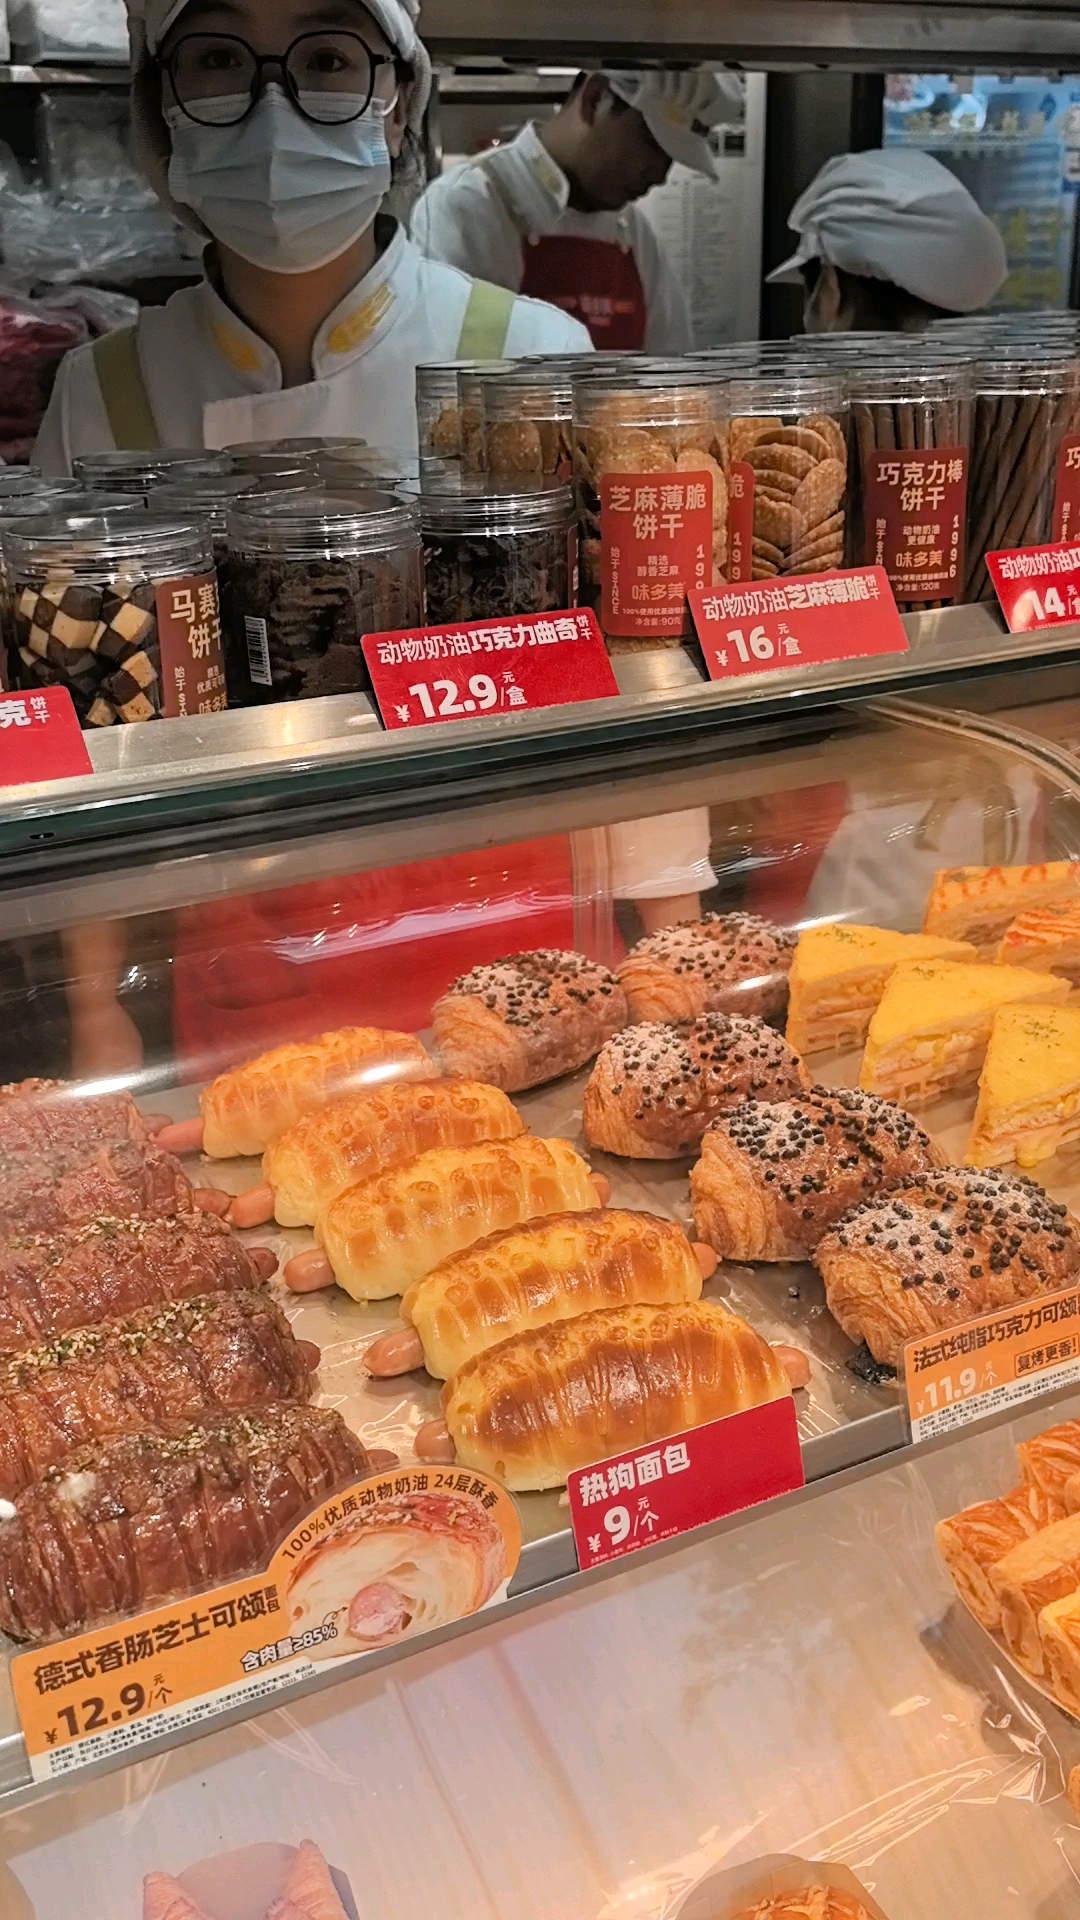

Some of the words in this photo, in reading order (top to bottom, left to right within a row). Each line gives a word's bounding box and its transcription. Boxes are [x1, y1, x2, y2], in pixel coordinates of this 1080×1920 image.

[876, 459, 964, 486] 巧克力棒
[609, 483, 707, 512] 芝麻薄脆
[900, 487, 945, 512] 饼干
[633, 514, 684, 540] 饼干
[903, 524, 940, 535] 动物奶油
[647, 555, 669, 566] 精选
[896, 550, 943, 568] 味多美
[949, 515, 960, 578] 1996
[170, 581, 221, 624] 马赛
[632, 583, 684, 601] 味多美
[702, 575, 870, 621] 动物奶油芝麻薄脆
[864, 573, 881, 600] 饼干
[377, 617, 579, 665] 动物奶油巧克力曲奇
[576, 614, 593, 641] 饼干
[30, 696, 50, 724] 饼干
[913, 1294, 1078, 1373] 法式纯脂巧克力可颂
[579, 1442, 691, 1507] 热狗面包
[281, 1473, 429, 1560] 100%优质动物奶油
[434, 1473, 499, 1511] 24层酥香
[33, 1590, 267, 1695] 德式香肠芝士可颂
[263, 1584, 281, 1614] 面包
